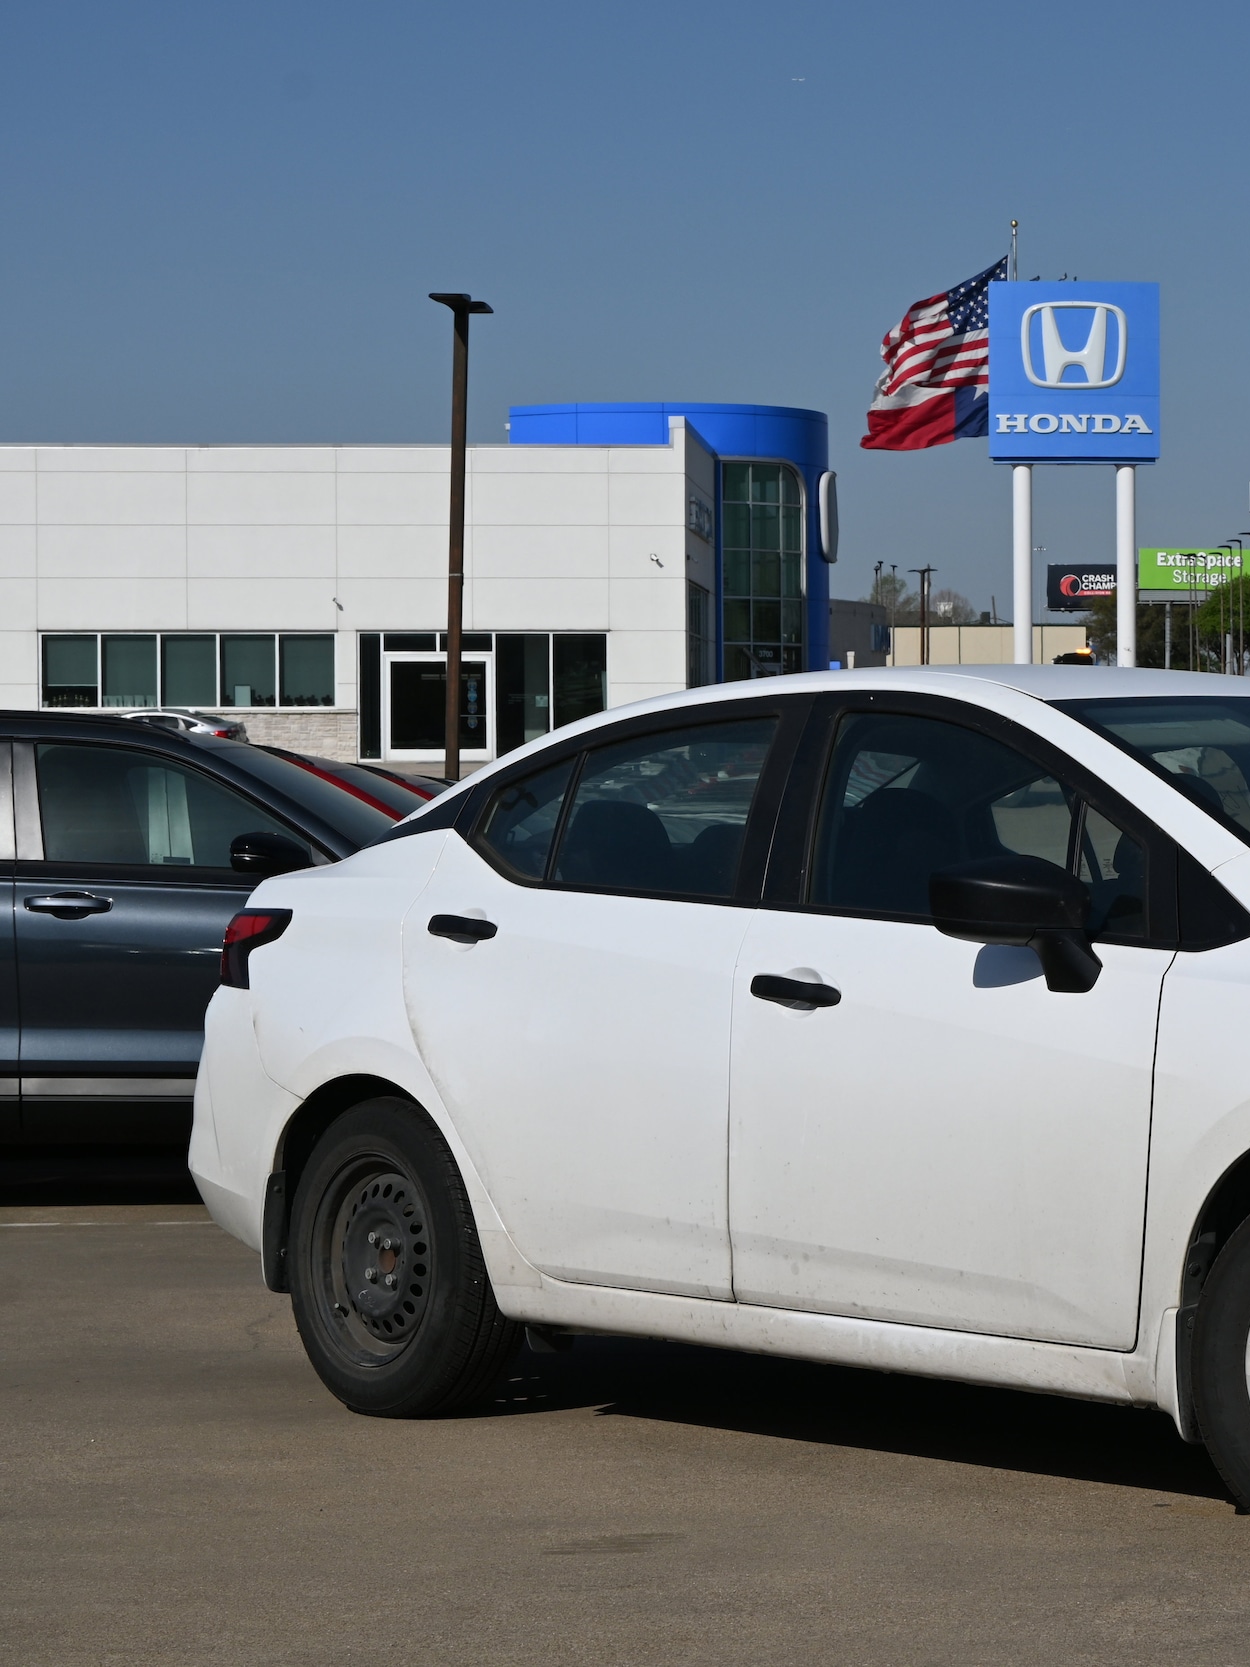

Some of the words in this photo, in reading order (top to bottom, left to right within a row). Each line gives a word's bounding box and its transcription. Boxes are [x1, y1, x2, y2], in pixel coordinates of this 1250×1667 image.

[995, 413, 1153, 434] HONDA
[1082, 574, 1114, 582] CRASH
[1172, 569, 1227, 586] Storage
